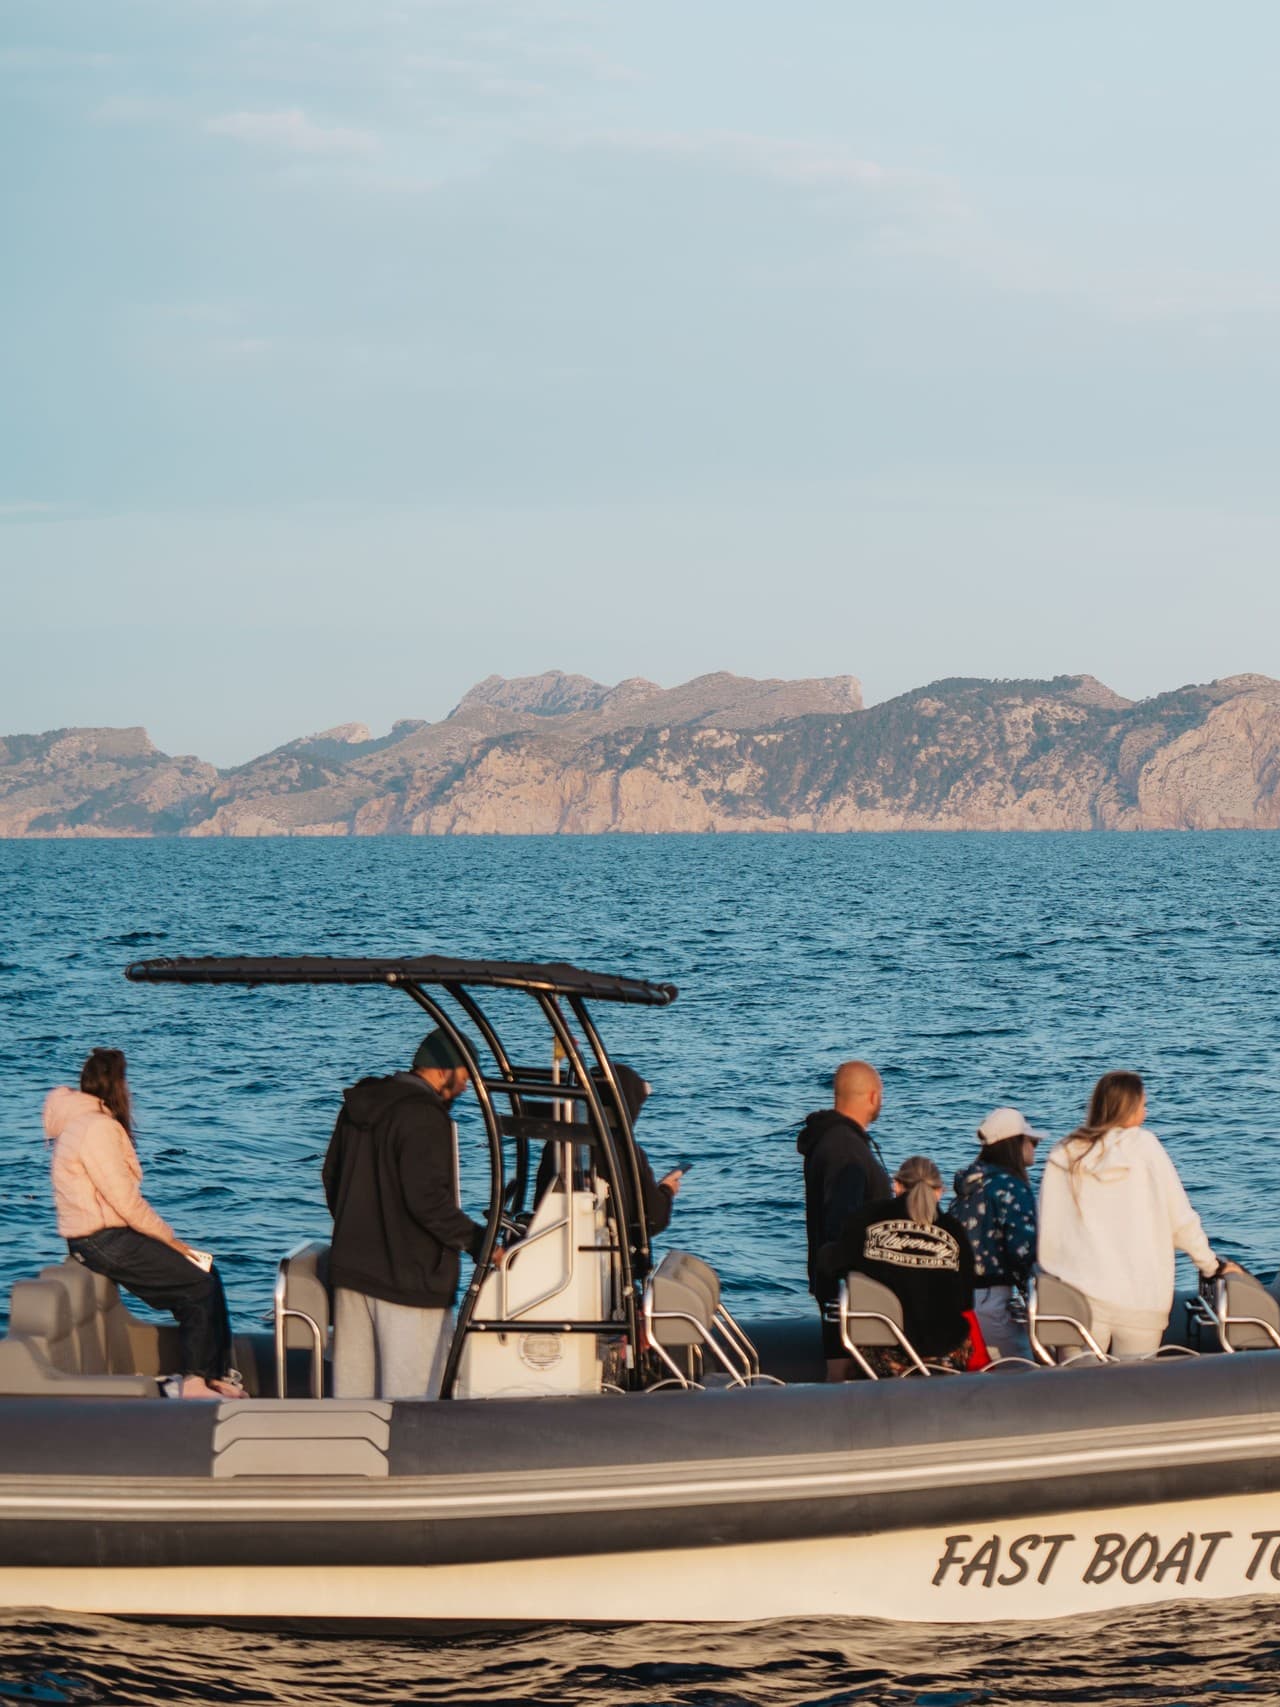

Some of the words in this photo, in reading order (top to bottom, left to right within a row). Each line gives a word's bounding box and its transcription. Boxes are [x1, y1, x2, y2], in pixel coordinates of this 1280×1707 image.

[875, 1231, 952, 1258] University
[920, 1257, 944, 1266] CLUB
[931, 1534, 1076, 1588] FAST
[1082, 1530, 1232, 1586] BOAT
